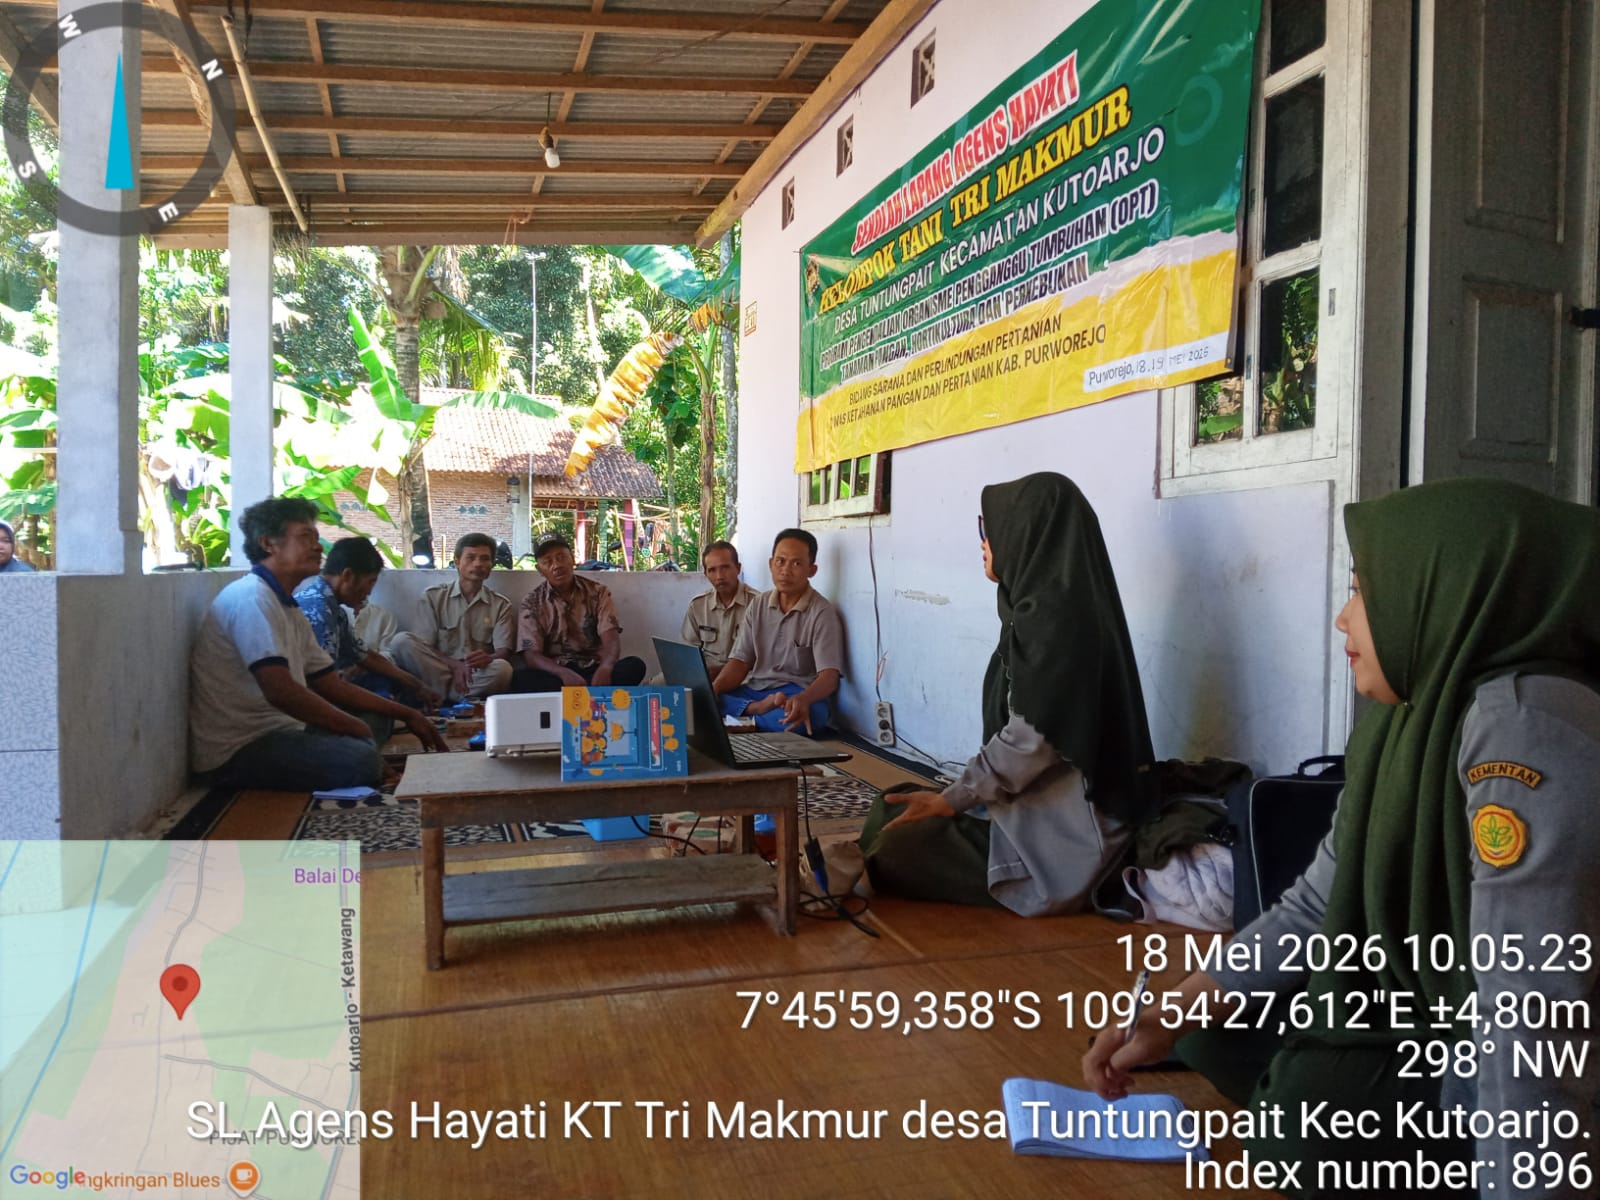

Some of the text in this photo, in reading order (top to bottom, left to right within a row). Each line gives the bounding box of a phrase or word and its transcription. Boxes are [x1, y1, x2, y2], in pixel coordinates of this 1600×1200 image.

[819, 85, 1132, 314] KELOMPOK TANI TRI MAKMUR
[852, 51, 1080, 253] SEKOLAH LAPANG AGENS HAYATI
[834, 126, 1166, 335] DESA TUNTUNGPAIT KECAMATAN KUTOARJO
[902, 289, 954, 329] ORGANISME
[955, 252, 1028, 305] PENGGANGGU
[1029, 205, 1108, 268] TUMBUHAN
[1110, 180, 1159, 232] (OPT)
[841, 351, 875, 381] TANAMAN
[911, 311, 976, 354] HORTIKULTURA
[978, 295, 1003, 325] DAN
[1004, 254, 1089, 315] PERKEBUNAN
[846, 401, 886, 423] KETAHANAN
[886, 389, 921, 410] PANGAN
[922, 383, 942, 401] DAN
[942, 361, 994, 394] PERTANIAN
[995, 354, 1021, 374] KAB.
[1023, 324, 1106, 368] PURWOREJO
[849, 312, 1062, 405] BIDANG SARANA DAN PERLINDUNGAN PERTANIAN
[1470, 763, 1538, 785] KEMENTAN
